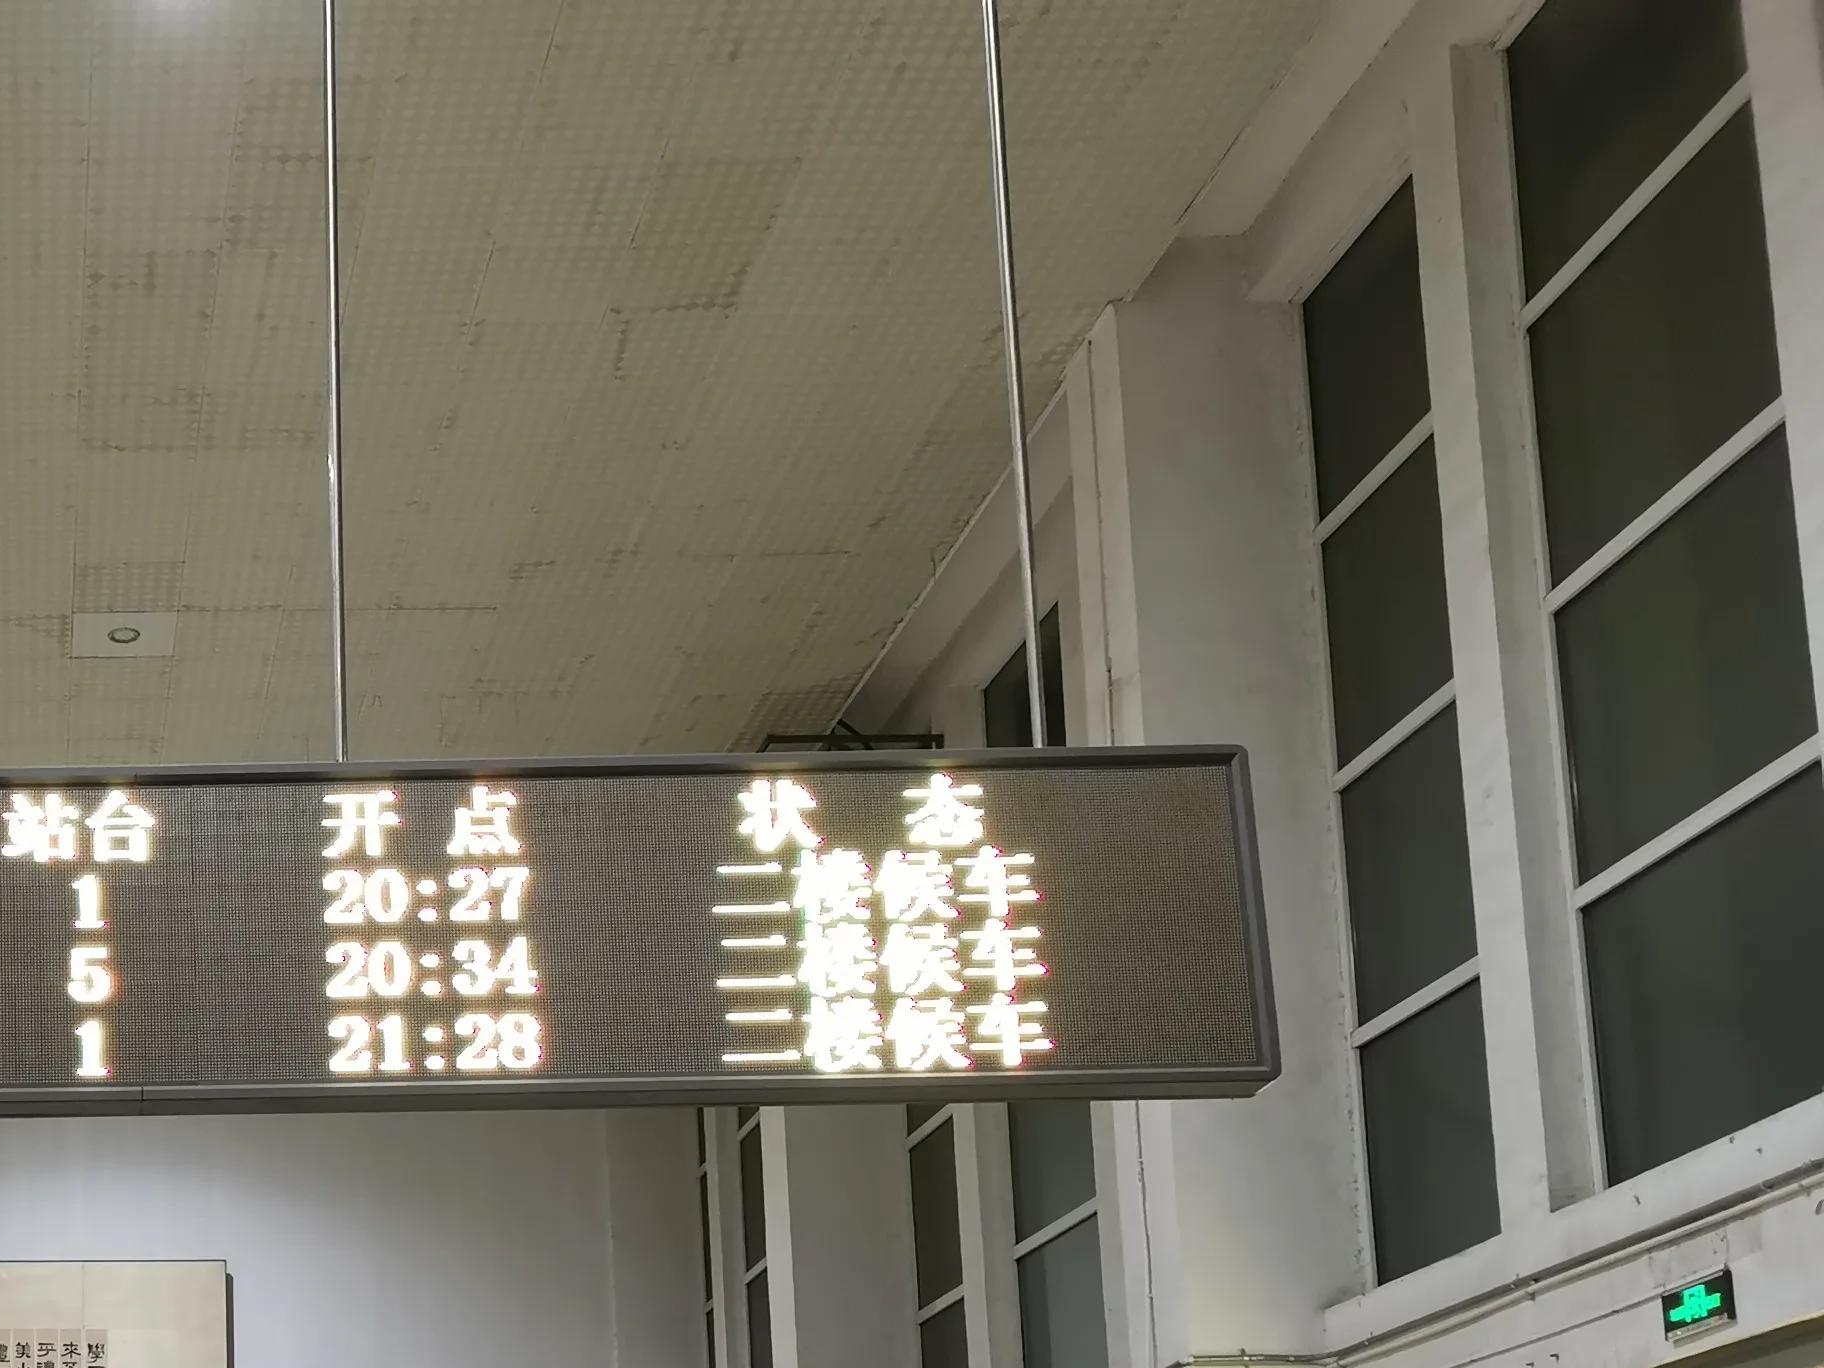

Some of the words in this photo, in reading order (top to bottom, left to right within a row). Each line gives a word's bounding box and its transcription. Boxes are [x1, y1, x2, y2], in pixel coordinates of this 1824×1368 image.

[0, 789, 161, 864] 站台
[320, 785, 523, 859] 开点
[737, 772, 984, 852] 状态
[68, 874, 106, 931] 1
[321, 866, 530, 925] 20:27
[712, 846, 1044, 922] 二楼候车
[67, 944, 111, 1003] 5
[325, 935, 539, 998] 20:34
[717, 918, 1049, 996] 二楼候车
[74, 1020, 109, 1077] 1
[327, 1010, 543, 1072] 21:28
[722, 992, 1055, 1072] 二楼候车
